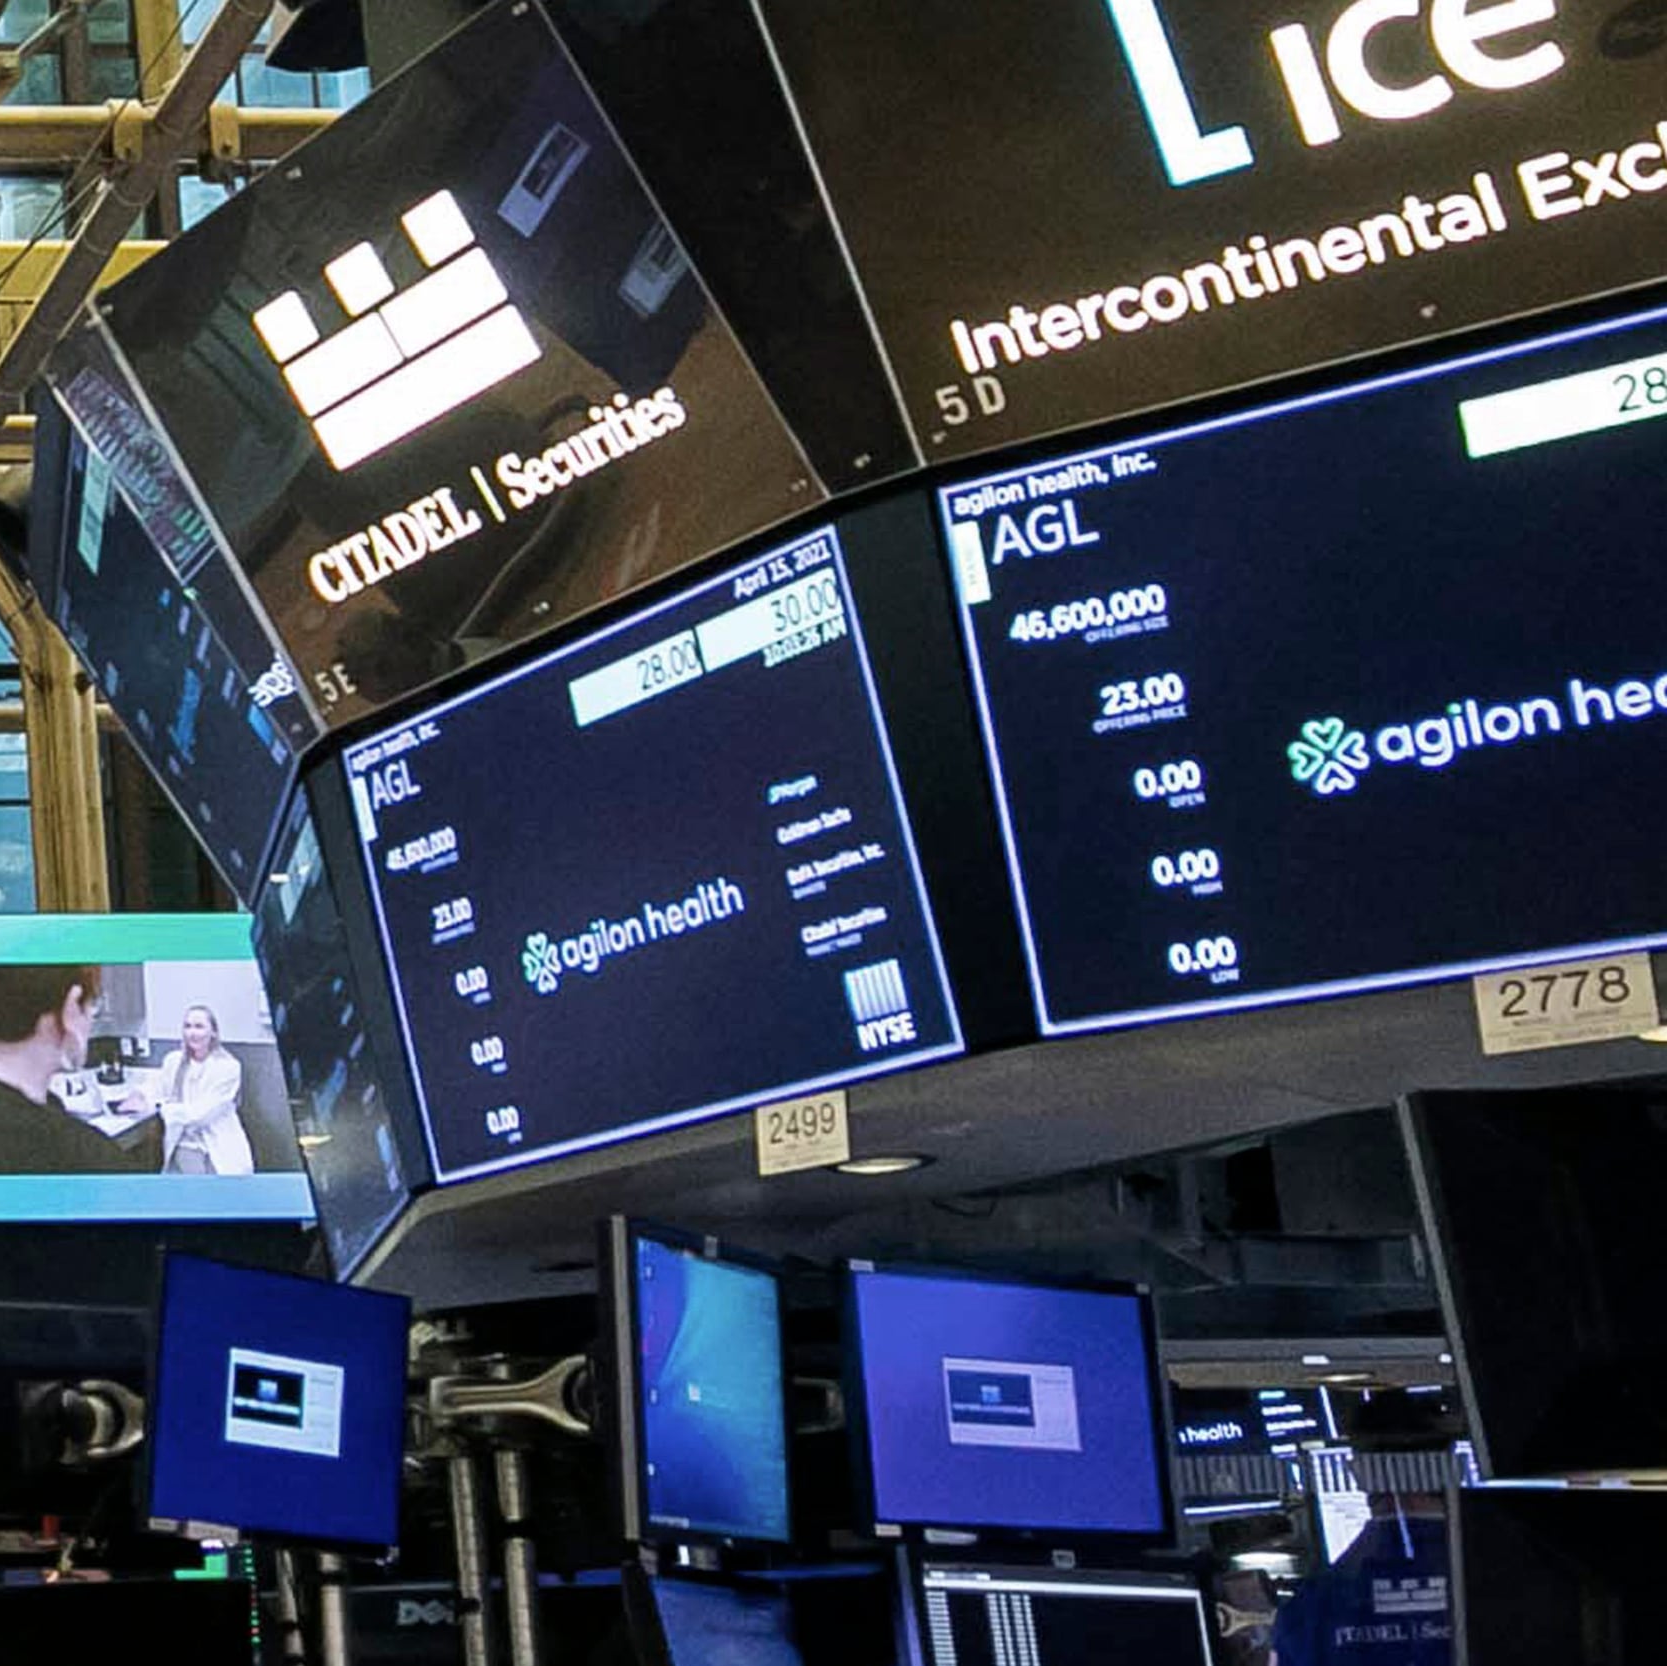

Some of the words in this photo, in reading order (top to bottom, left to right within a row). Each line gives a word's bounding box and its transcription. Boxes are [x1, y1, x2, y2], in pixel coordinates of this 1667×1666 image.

[952, 172, 1508, 375] Intercontinental
[1517, 120, 1667, 221] Exc
[307, 487, 481, 603] CITADEL
[495, 386, 688, 511] Securities
[952, 482, 1025, 516] agilon
[1027, 462, 1109, 498] health,
[991, 500, 1100, 565] AGL
[733, 566, 768, 600] April
[793, 540, 832, 571] 2021
[770, 578, 838, 632] 30.00
[1009, 584, 1167, 642] 46,600,000
[636, 639, 698, 690] 28.00
[1099, 672, 1184, 716] 23.00
[1376, 699, 1562, 767] agilon
[370, 758, 422, 810] AGL
[1134, 759, 1202, 799] 0.00
[1152, 849, 1220, 887] 0.00
[561, 913, 645, 971] agilon
[646, 876, 745, 937] health
[454, 966, 489, 996] 0.00
[1168, 936, 1237, 976] 0.00
[1499, 966, 1630, 1018] 2778
[470, 1035, 505, 1066] 0.00
[856, 1011, 917, 1052] NYSE
[485, 1104, 520, 1135] 0.00
[767, 1111, 838, 1146] 2499
[1188, 1421, 1243, 1443] health
